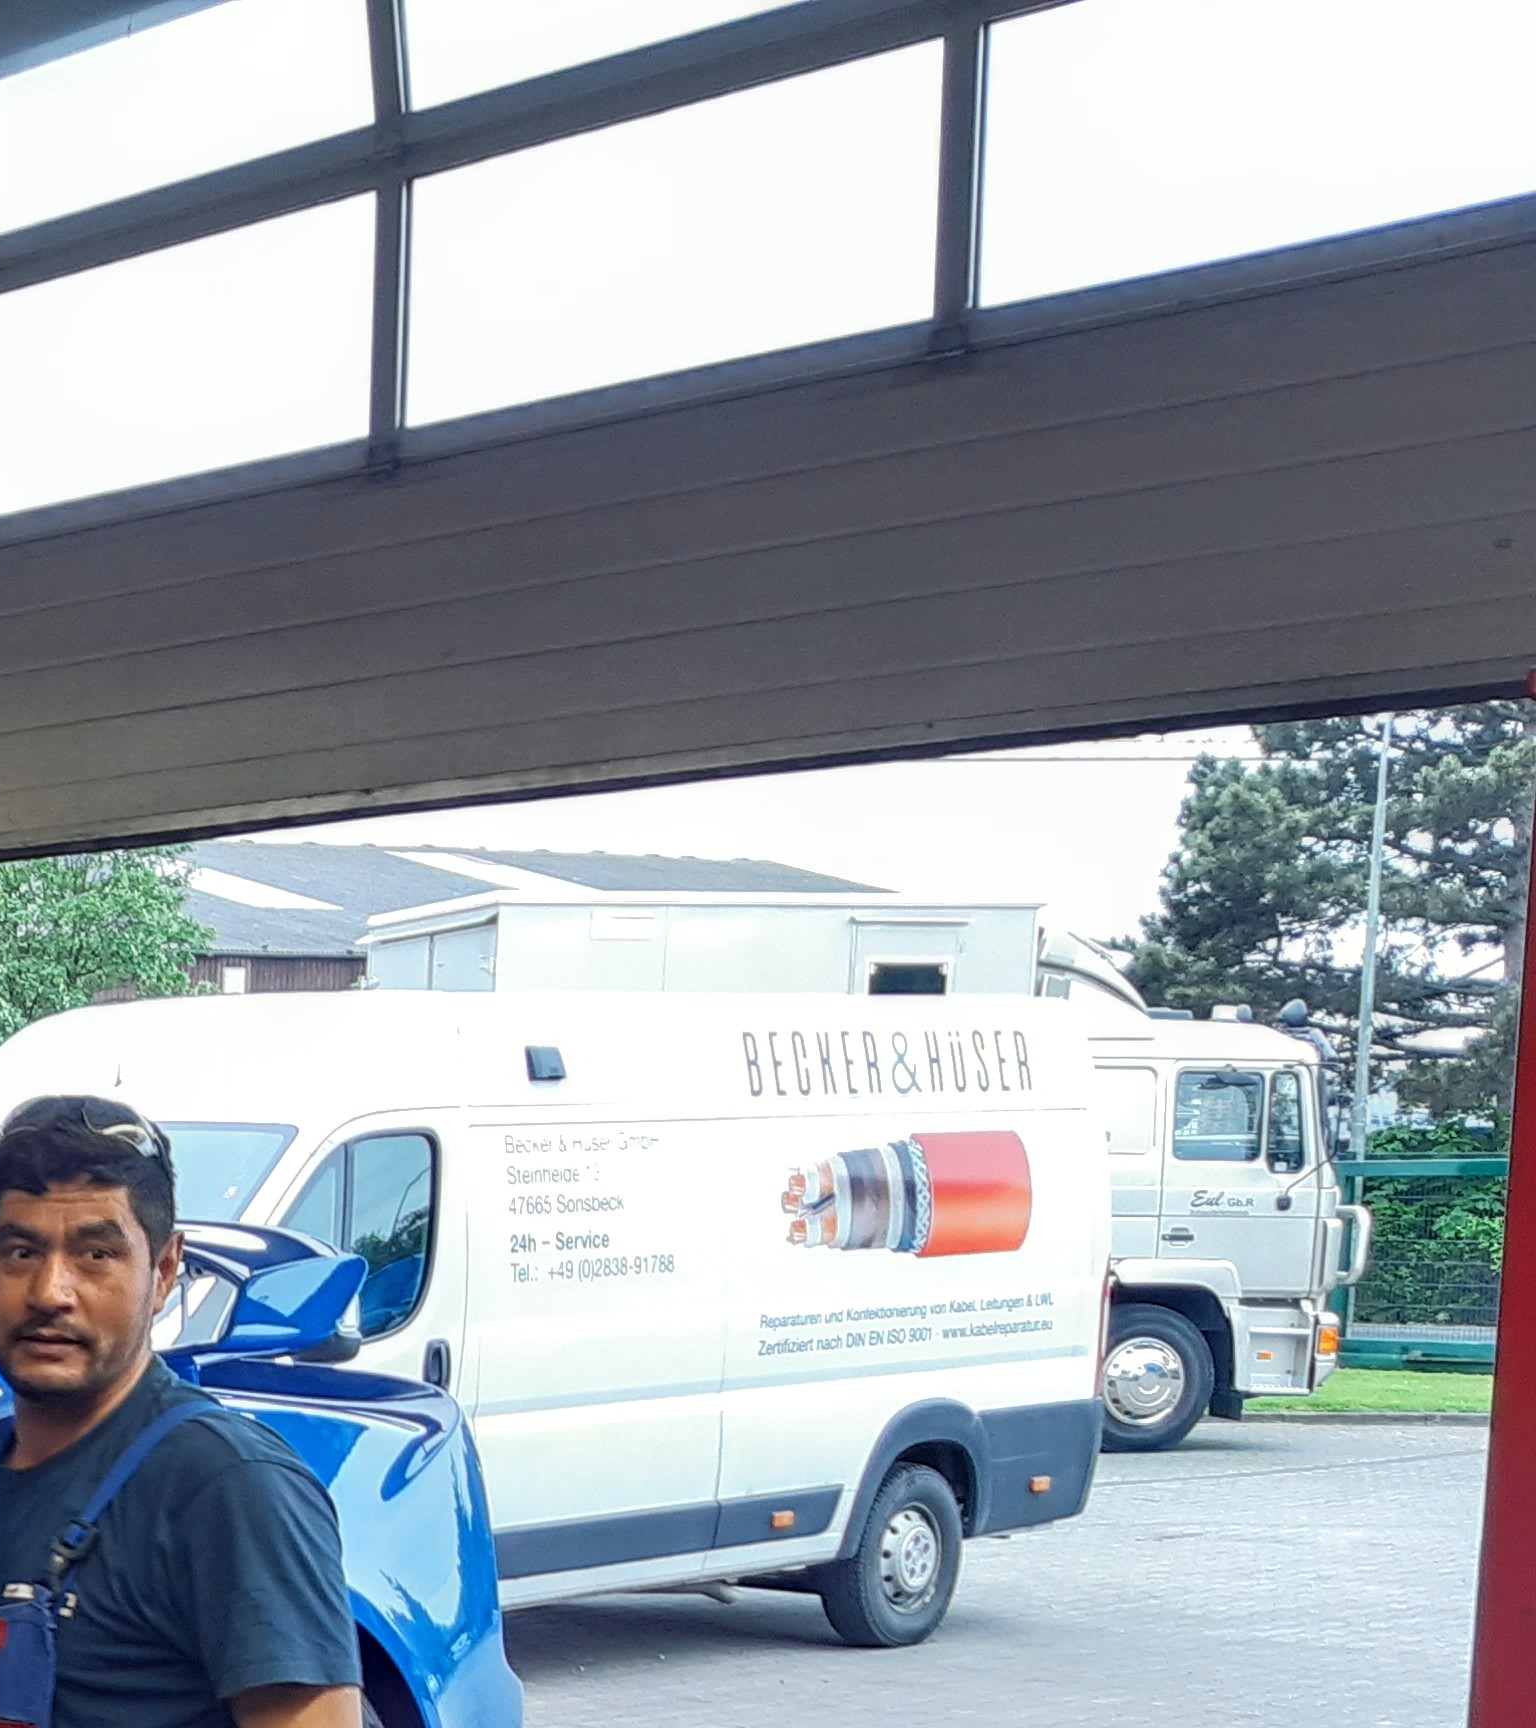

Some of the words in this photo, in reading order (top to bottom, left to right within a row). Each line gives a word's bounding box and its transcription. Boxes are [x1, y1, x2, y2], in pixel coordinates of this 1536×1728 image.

[508, 1194, 553, 1215] 47665
[556, 1193, 625, 1214] Sonsbeck
[510, 1233, 537, 1254] 24h
[554, 1230, 610, 1251] Service
[510, 1262, 539, 1283] Tel.:
[547, 1259, 574, 1281] +49
[577, 1253, 676, 1283] (0)2838-91788
[759, 1312, 823, 1332] Reparaturen
[824, 1309, 844, 1324] und
[929, 1303, 946, 1315] von
[979, 1296, 1025, 1313] Leitungen
[757, 1336, 815, 1357] Zertifiziert
[816, 1333, 843, 1352] nach
[845, 1331, 867, 1349] DIN
[868, 1329, 885, 1347] EN
[886, 1327, 907, 1345] ISO
[908, 1325, 933, 1344] 9001
